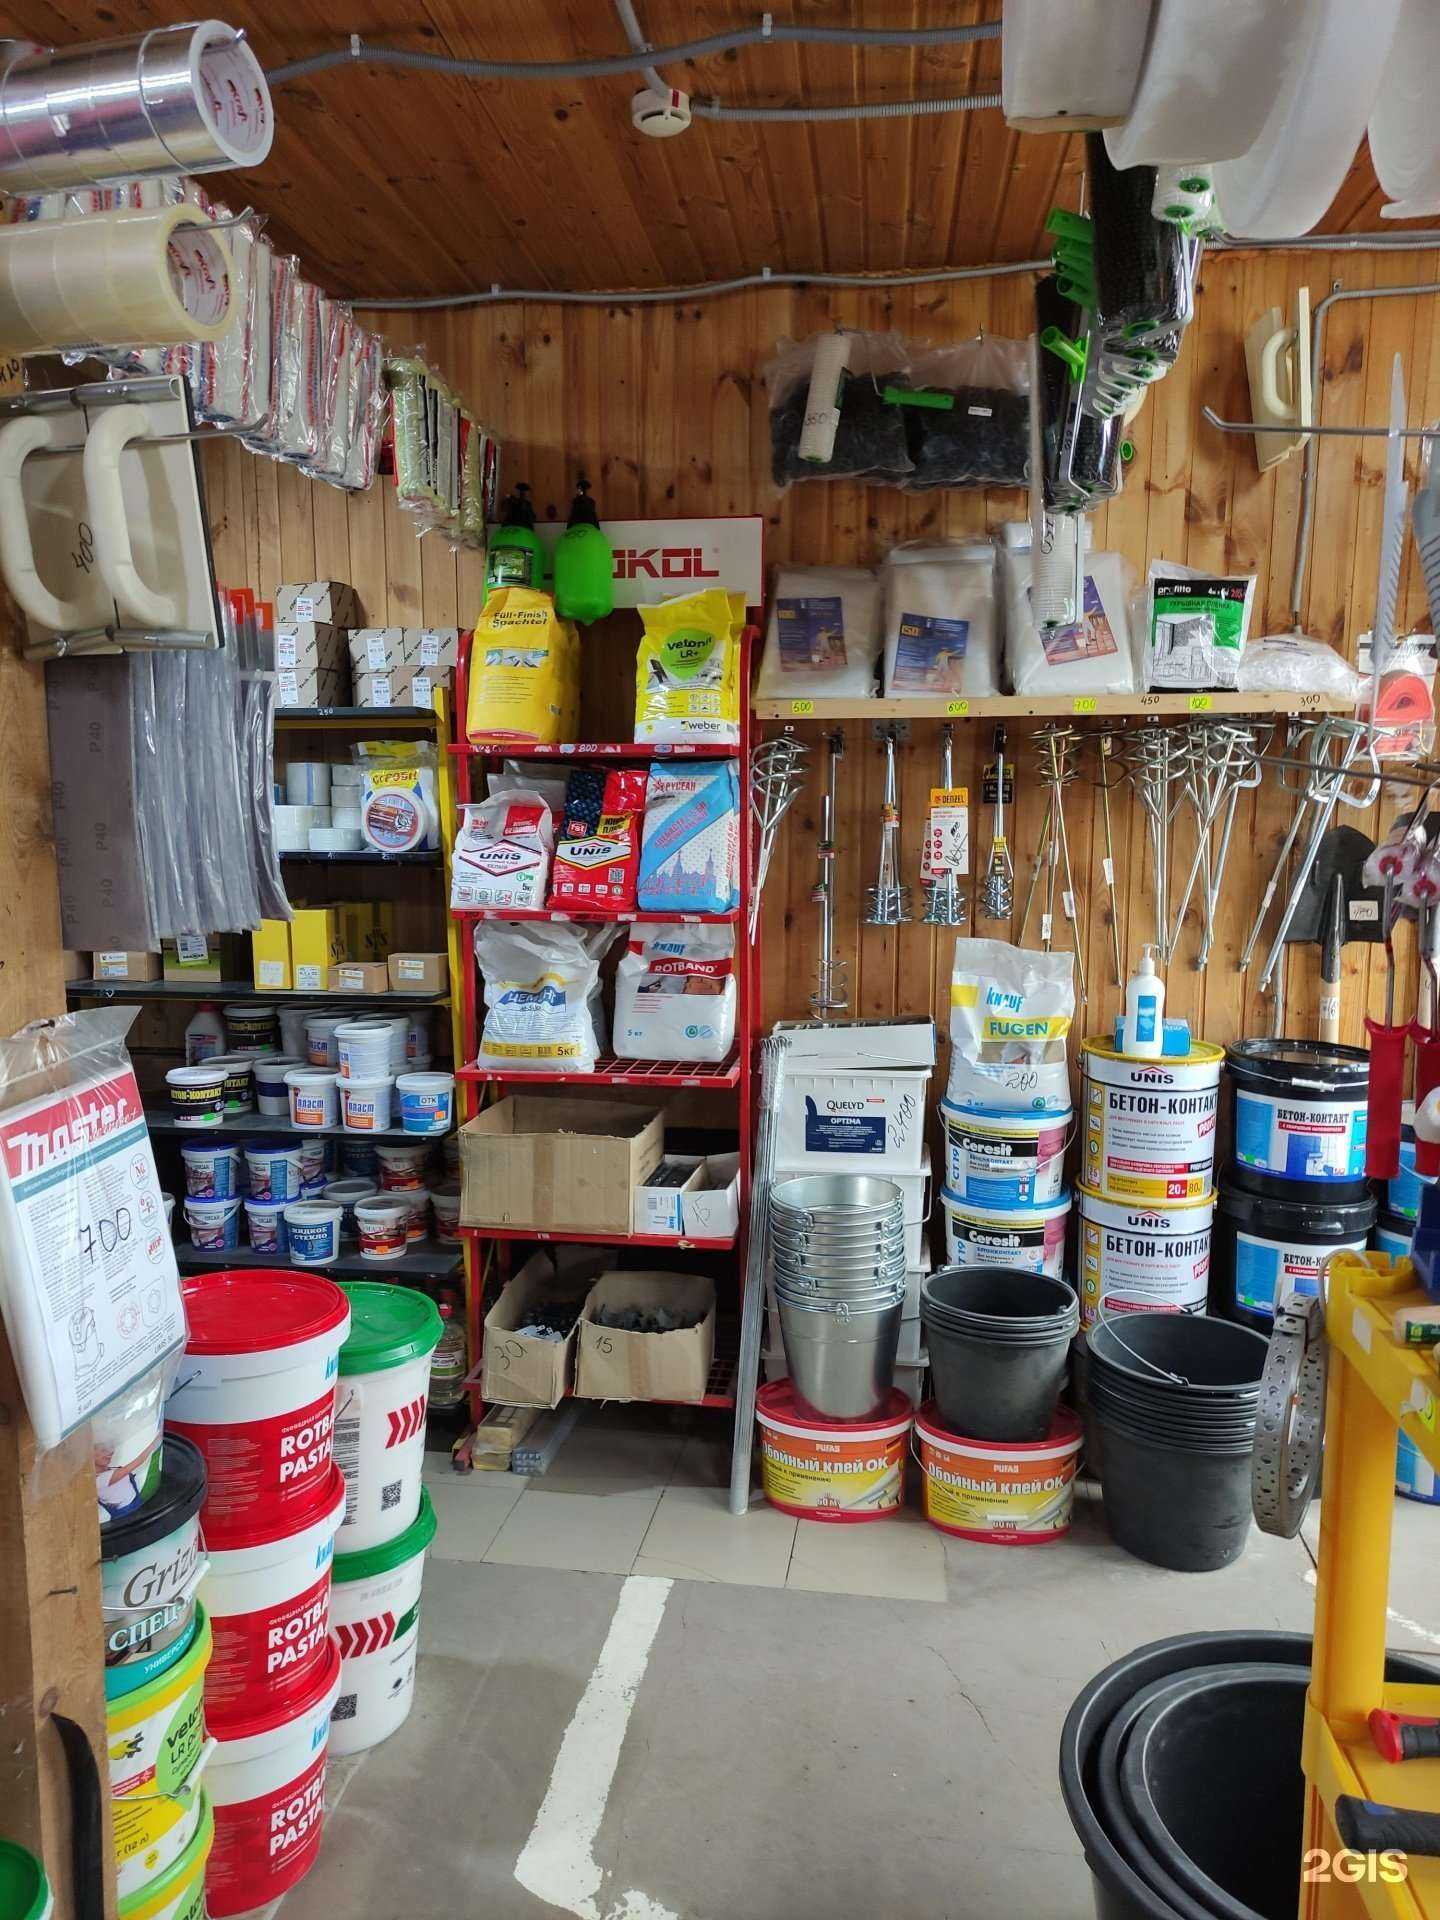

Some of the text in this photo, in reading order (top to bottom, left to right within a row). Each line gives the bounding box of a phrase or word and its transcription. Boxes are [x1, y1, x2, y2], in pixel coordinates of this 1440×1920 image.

[71, 521, 94, 574] 400
[492, 618, 548, 628] Spachtel
[948, 702, 968, 712] 600
[1141, 695, 1160, 705] 450
[688, 720, 721, 731] weber
[942, 795, 965, 804] DENZEL
[96, 822, 108, 852] P40
[479, 852, 523, 862] UNIS
[570, 846, 612, 856] UNIS
[653, 961, 716, 974] ROTBAND
[989, 1021, 1049, 1036] FUGEN
[1005, 1071, 1038, 1091] 200
[1130, 1072, 1174, 1084] UNIS
[826, 1099, 865, 1112] QUELYD
[1109, 1092, 1218, 1115] БЕТОН-КОНТАКТ
[830, 1117, 862, 1125] OPTIMA
[887, 1092, 917, 1149] 2400
[1277, 1108, 1350, 1124] БЕТОН-КОНТАКТ
[962, 1137, 1013, 1156] Ceresit
[1168, 1184, 1180, 1195] 20
[1127, 1215, 1170, 1228] UNIS
[79, 1207, 131, 1264] 700
[968, 1230, 1021, 1247] Ceresit
[595, 1335, 613, 1354] 15
[815, 1443, 841, 1453] PUFAS
[279, 1436, 332, 1483] PASTA
[823, 1459, 863, 1475] клей
[993, 1464, 1020, 1473] PUFAS
[928, 1462, 997, 1493] Обойный
[1000, 1479, 1041, 1496] клей
[267, 1622, 326, 1674] PASTA
[269, 1796, 323, 1857] PASTA
